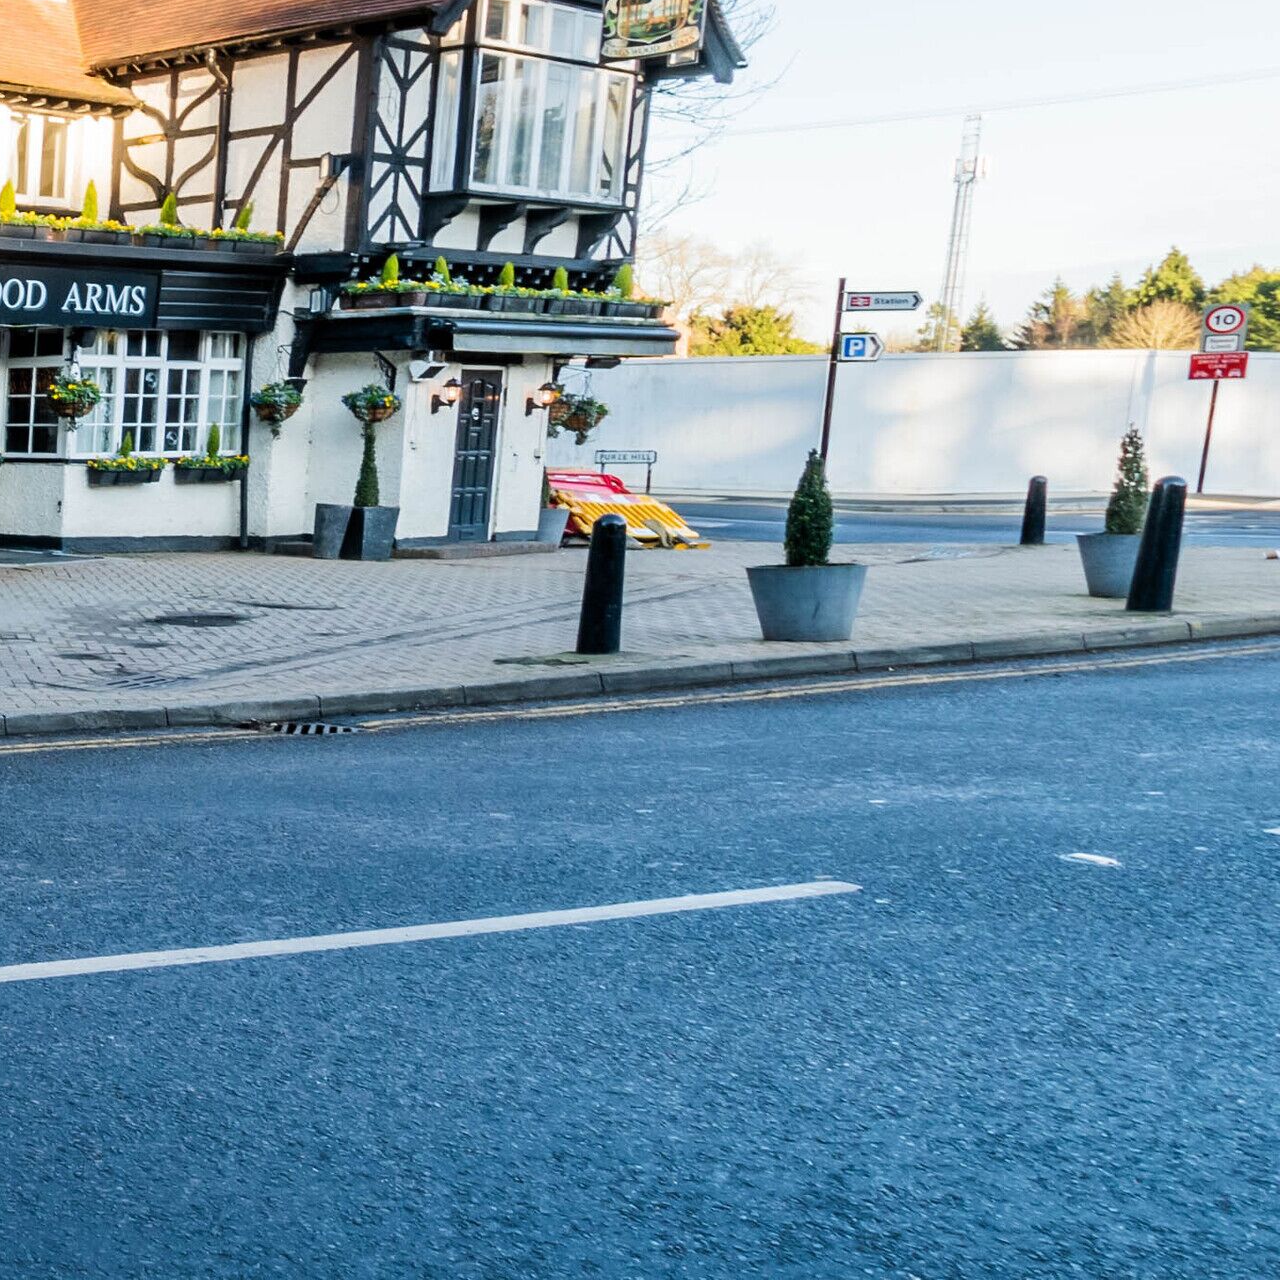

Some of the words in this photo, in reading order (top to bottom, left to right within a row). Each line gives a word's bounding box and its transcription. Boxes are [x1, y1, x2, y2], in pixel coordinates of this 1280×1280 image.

[60, 281, 146, 315] ARMS
[874, 297, 909, 305] Station
[1214, 314, 1236, 325] 10
[848, 339, 864, 357] P
